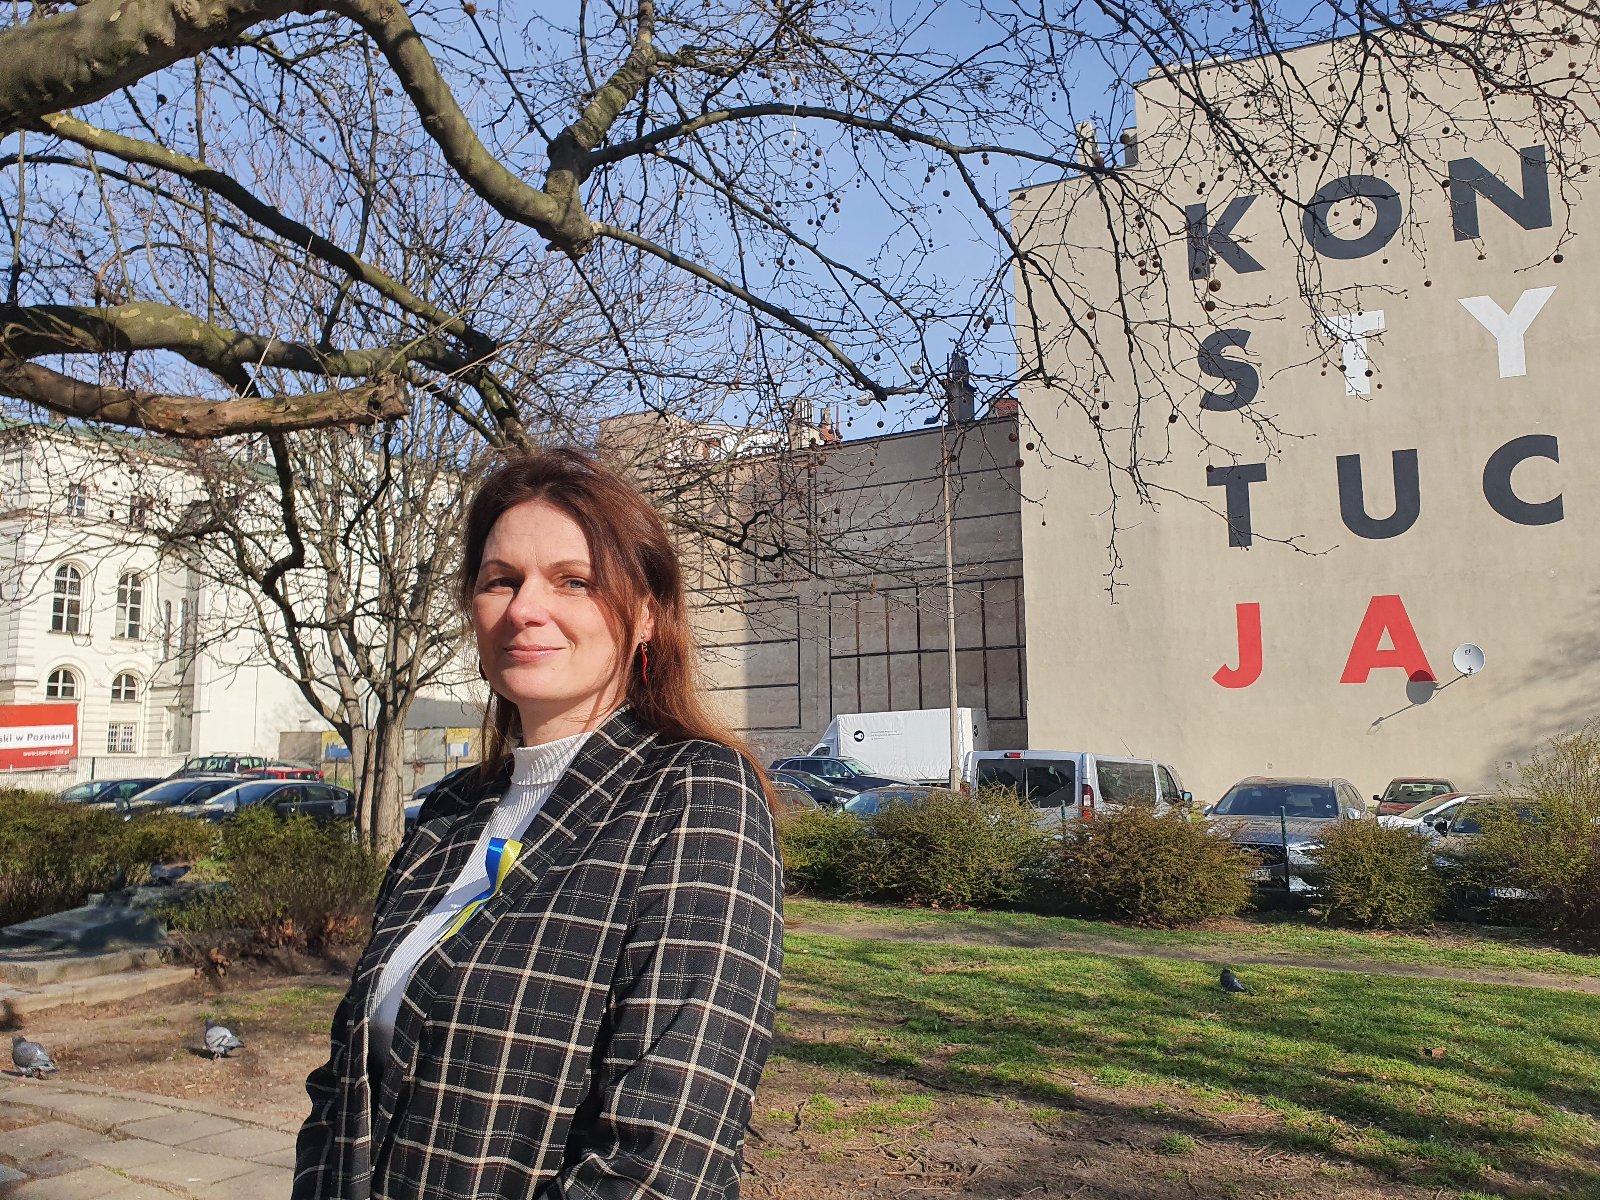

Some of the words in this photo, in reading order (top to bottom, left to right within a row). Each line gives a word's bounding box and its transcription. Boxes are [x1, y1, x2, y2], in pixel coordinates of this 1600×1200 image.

[1185, 145, 1553, 281] KON
[1198, 285, 1557, 412] STY
[1206, 434, 1565, 548] TUC
[1211, 594, 1437, 689] JA
[27, 731, 70, 742] Poznaniu
